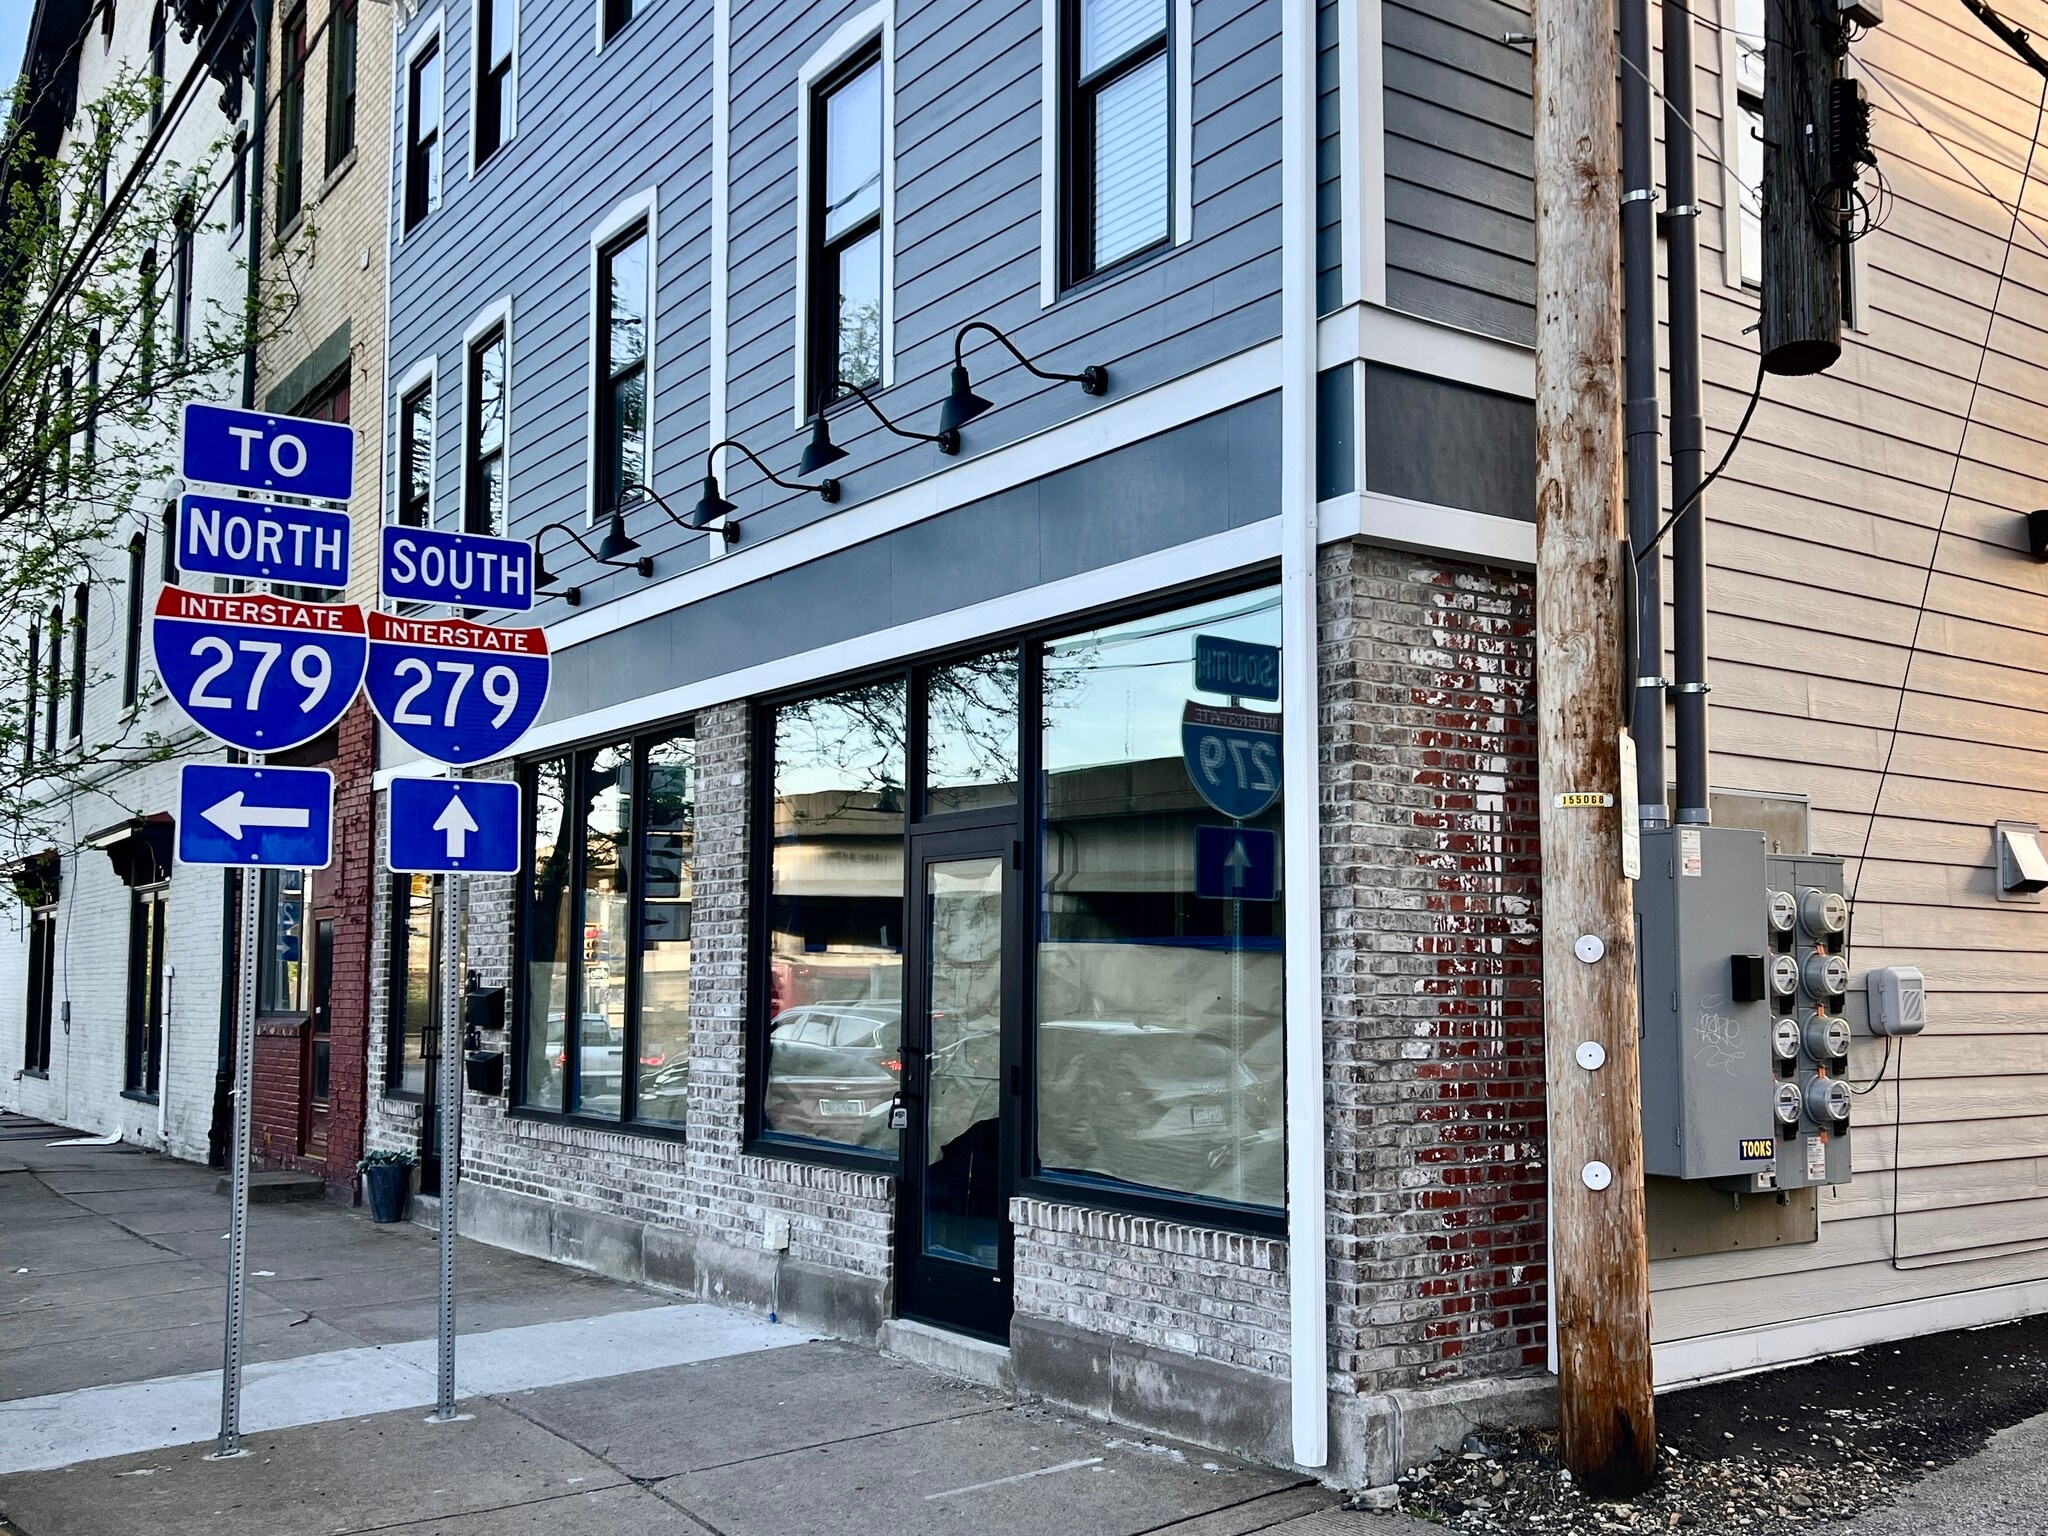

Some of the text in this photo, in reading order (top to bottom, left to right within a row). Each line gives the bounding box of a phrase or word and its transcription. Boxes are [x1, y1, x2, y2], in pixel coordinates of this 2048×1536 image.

[228, 426, 307, 478] TO
[188, 508, 342, 571] NORTH
[390, 538, 525, 596] SOUTH
[180, 596, 343, 630] INTERSTATE
[384, 621, 528, 652] INTERSTATE
[188, 636, 332, 714] 279
[393, 658, 520, 730] 279
[1562, 795, 1605, 805] 155068
[1742, 1140, 1772, 1158] TOOKS
